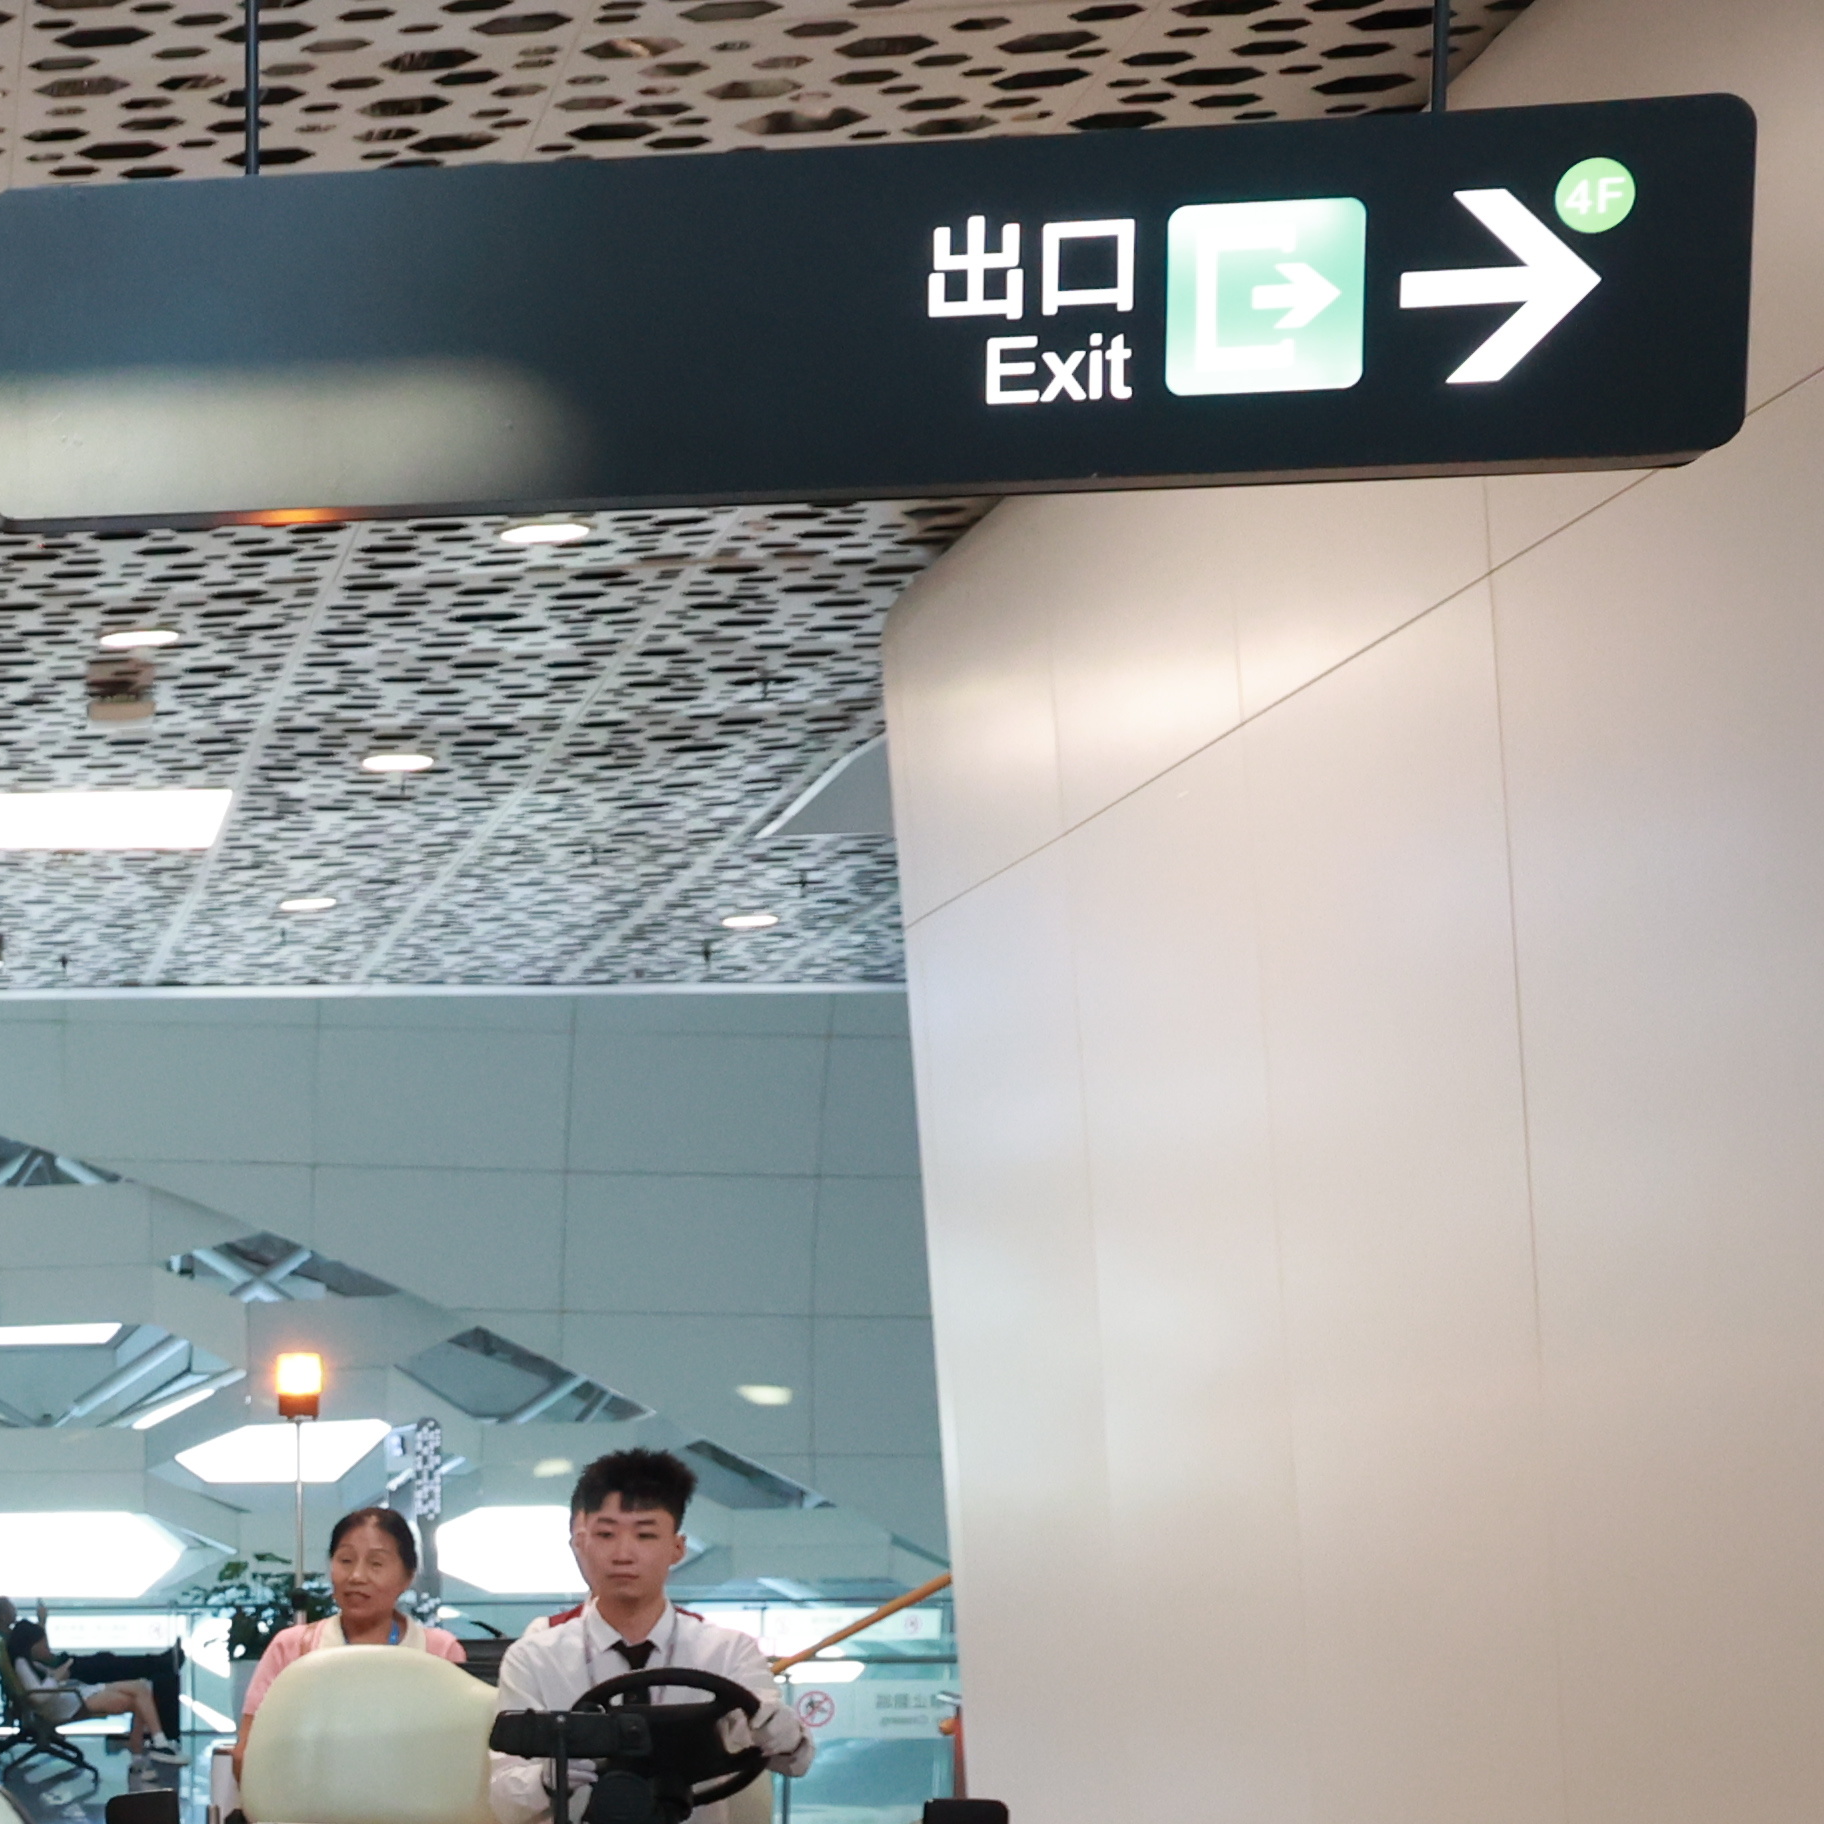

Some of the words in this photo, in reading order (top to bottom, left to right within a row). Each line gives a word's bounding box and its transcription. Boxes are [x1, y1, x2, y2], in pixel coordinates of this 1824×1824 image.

[1564, 175, 1626, 215] 4F
[927, 214, 1136, 321] 出口
[985, 332, 1132, 405] Exit
